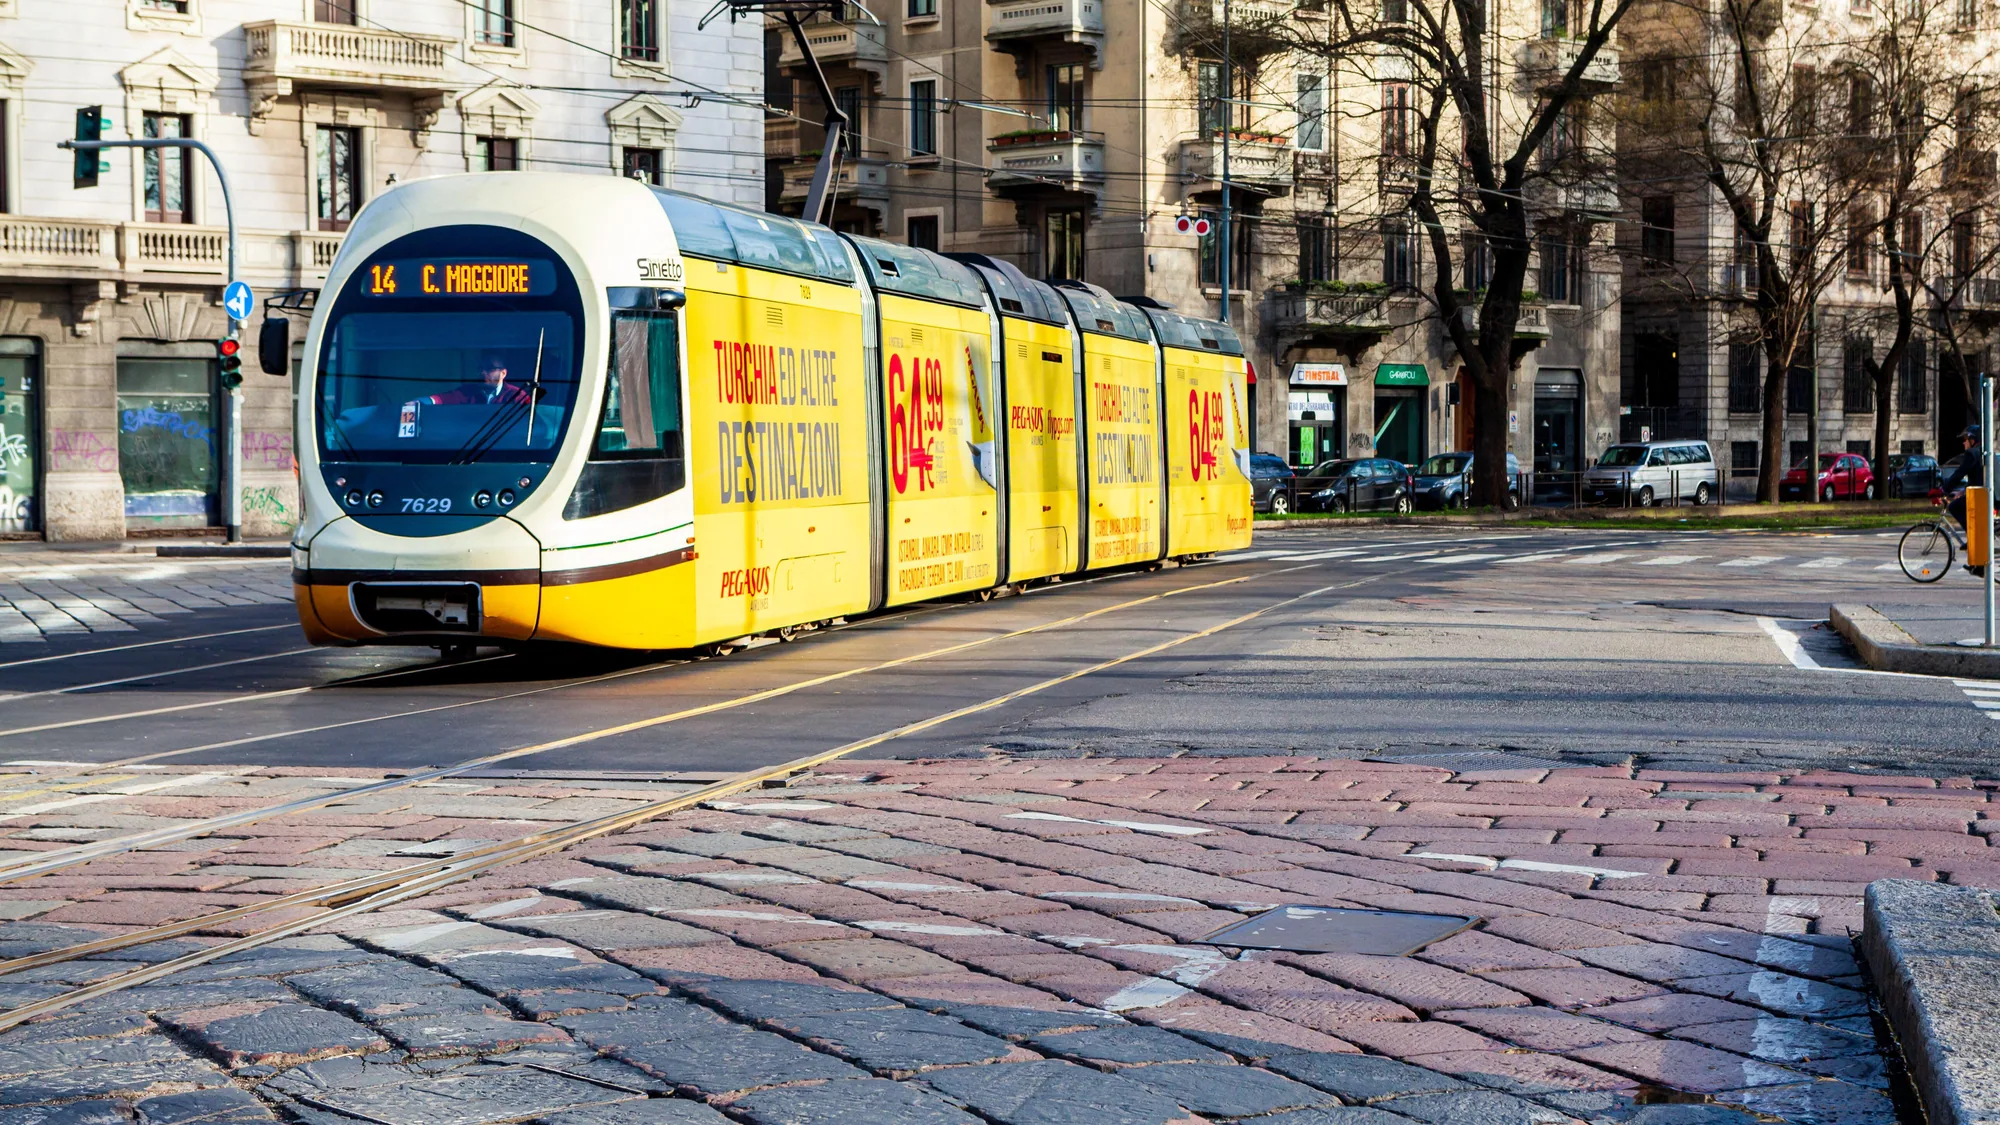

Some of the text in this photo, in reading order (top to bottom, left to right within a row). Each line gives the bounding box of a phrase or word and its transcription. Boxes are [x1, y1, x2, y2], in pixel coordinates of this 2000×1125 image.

[370, 264, 529, 294] 14 C. MAGGIORE
[636, 257, 683, 280] Sirietto
[713, 339, 839, 407] TURCHIA ED ALTRE
[1304, 369, 1340, 382] FINSTRAL
[1093, 382, 1122, 423] TURCHIA
[402, 425, 414, 436] 14
[1011, 405, 1044, 433] PEGASUS
[718, 420, 842, 505] DESTINAZIONI
[1096, 432, 1153, 485] DESTINAZIONI
[401, 497, 452, 513] 7629
[720, 565, 771, 599] PEGASUS
